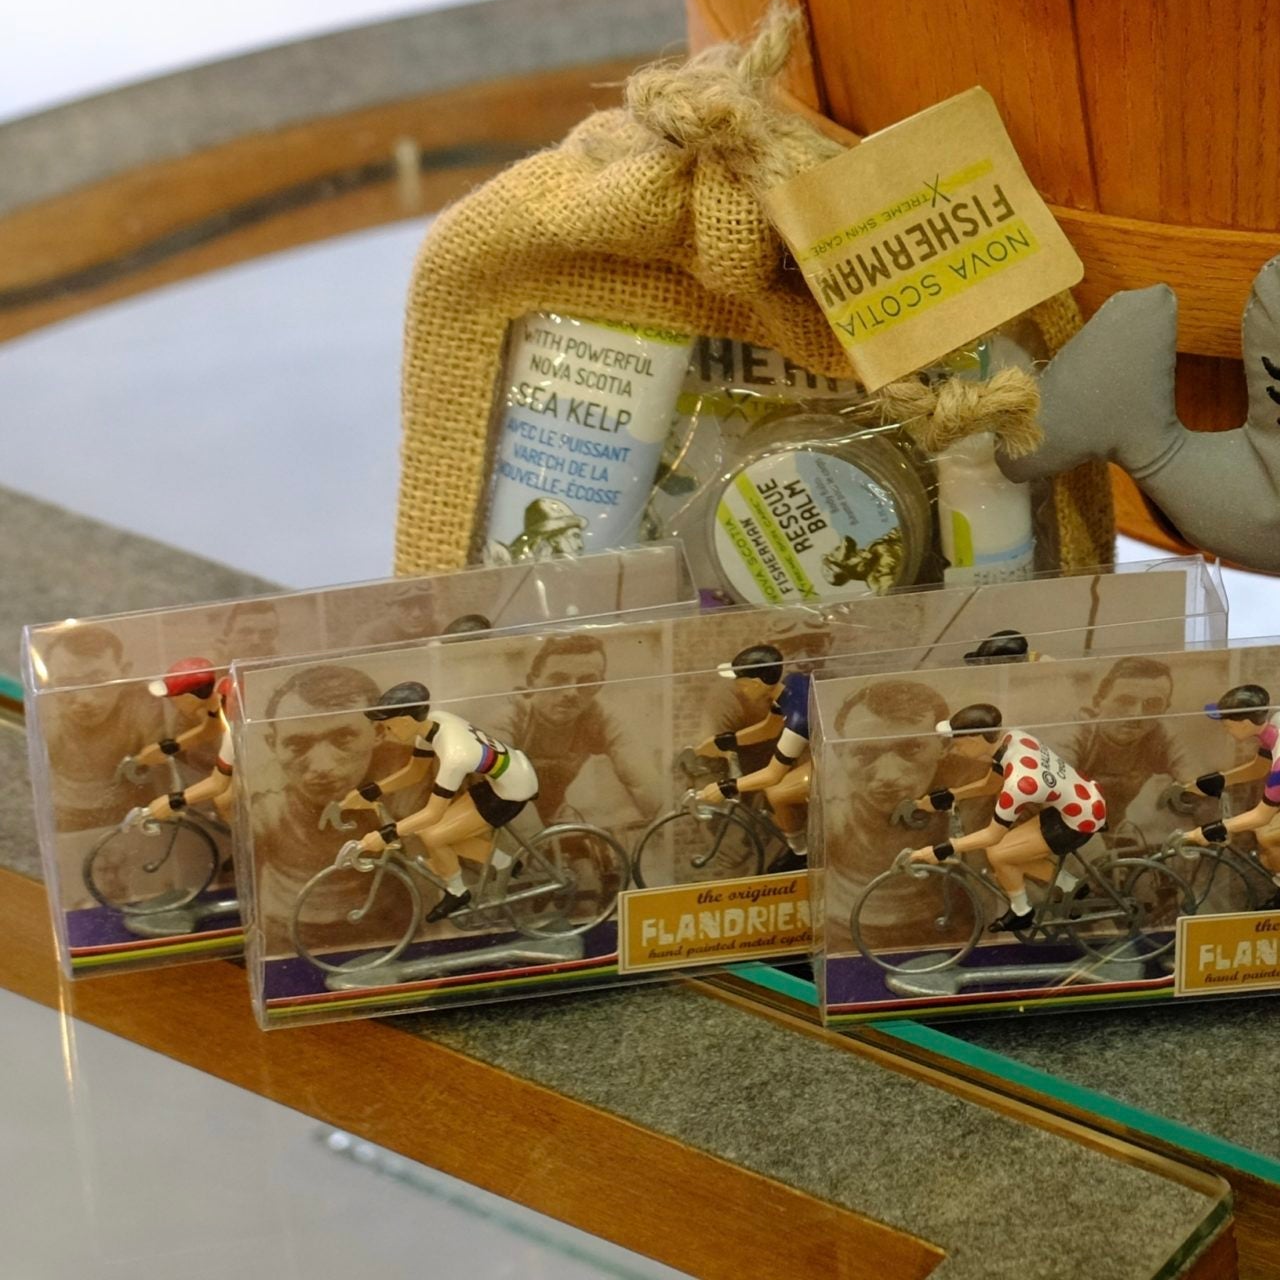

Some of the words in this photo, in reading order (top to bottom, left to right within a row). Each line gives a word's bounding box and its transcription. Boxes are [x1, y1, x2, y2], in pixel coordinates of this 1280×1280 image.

[880, 173, 952, 223] XTREME
[815, 184, 1016, 308] FISHERMAN
[846, 217, 878, 242] SKIN
[948, 228, 1031, 280] NOVA
[835, 274, 943, 338] SCOTIA
[522, 323, 564, 352] WITH
[565, 337, 655, 377] POWERFUL
[529, 354, 571, 382] NOVA
[574, 368, 633, 398] SCOTIA
[516, 381, 558, 419] SEA
[567, 397, 633, 434] KELP
[507, 417, 538, 441] AVEC
[539, 427, 558, 447] LE
[559, 433, 632, 463] PUISSANT
[513, 441, 566, 472] VARECH
[568, 459, 590, 478] DE
[590, 464, 609, 483] LA
[756, 477, 814, 555] RESCUE
[784, 479, 828, 535] BALM
[724, 517, 757, 566] SCOTIA
[740, 517, 794, 595] FISHERMAN
[697, 889, 724, 905] the
[728, 879, 798, 903] original
[648, 945, 683, 960] hand
[686, 939, 736, 956] painted
[738, 934, 777, 949] metal
[1254, 918, 1280, 933] the
[1204, 970, 1239, 984] hand
